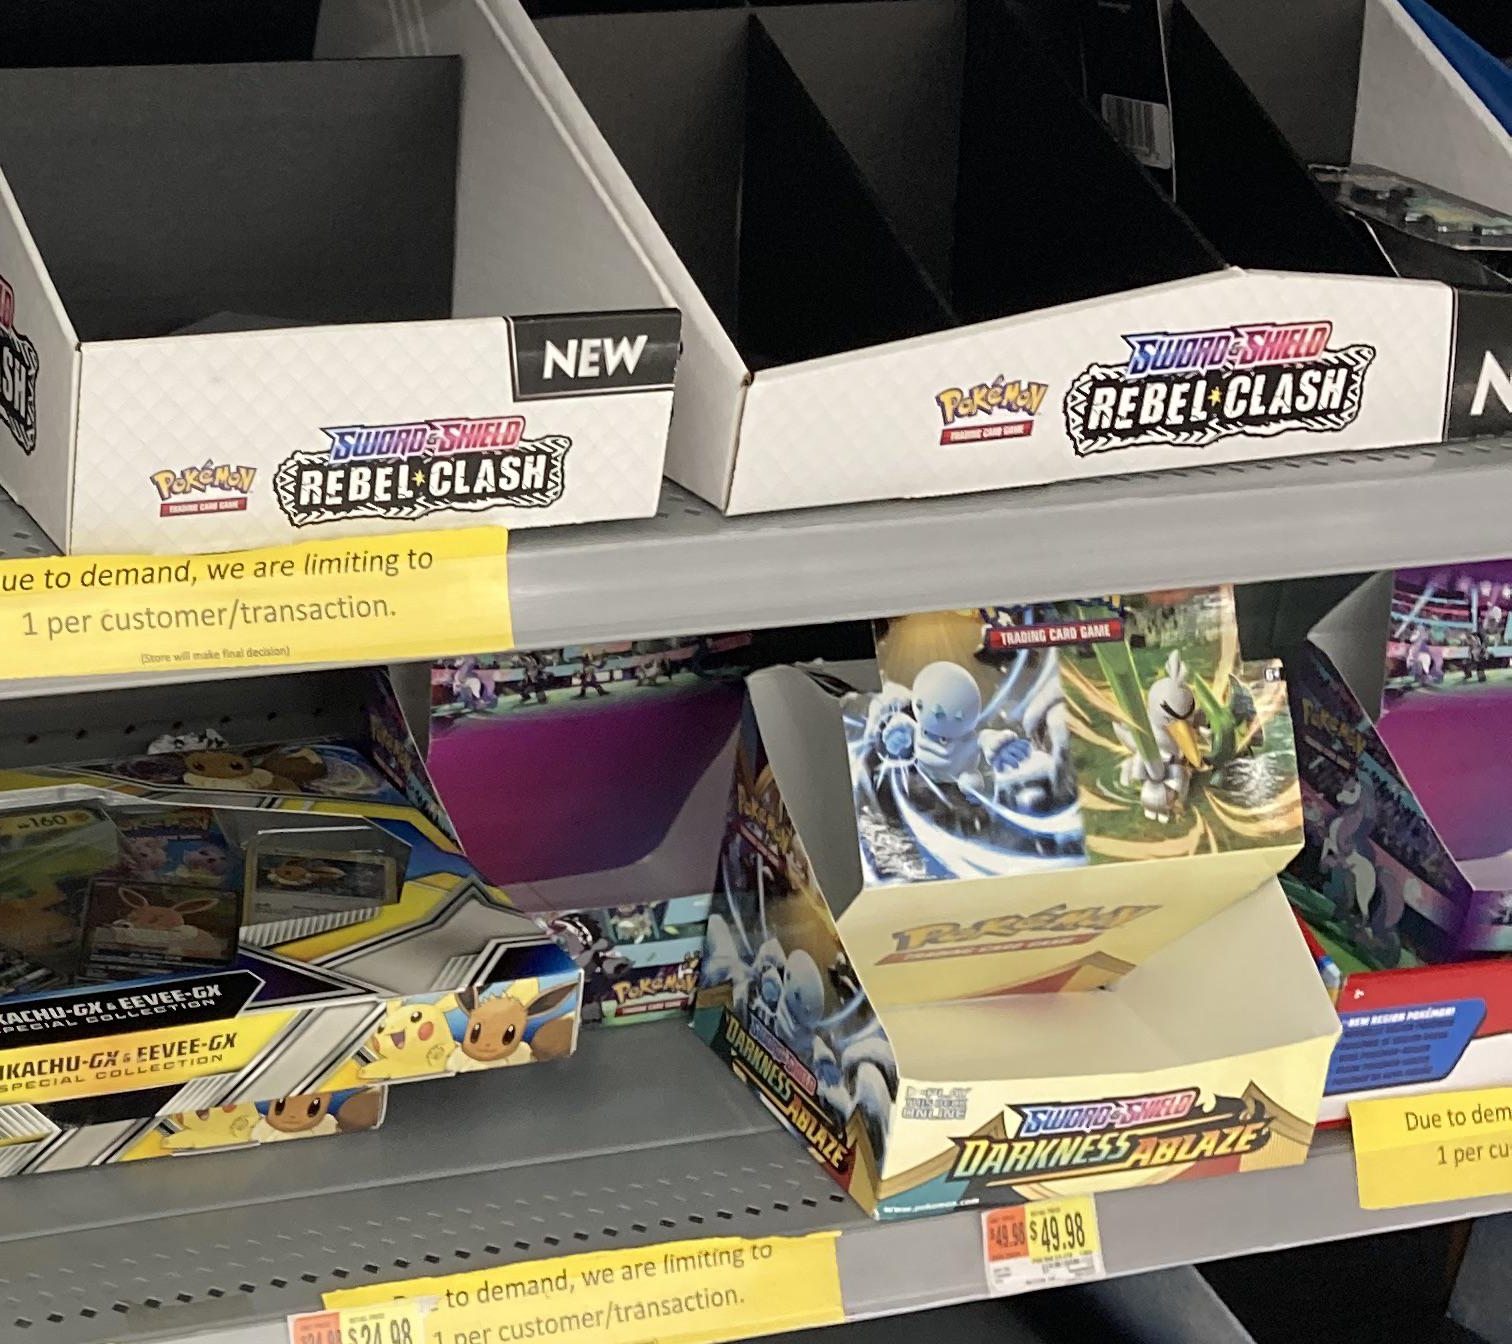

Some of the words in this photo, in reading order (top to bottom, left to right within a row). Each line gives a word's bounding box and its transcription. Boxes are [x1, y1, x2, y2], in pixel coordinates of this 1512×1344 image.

[542, 335, 648, 380] NEW
[1129, 332, 1232, 376] SWORD
[1240, 322, 1333, 368] SHIELD
[1088, 375, 1208, 430] REBEL
[1224, 368, 1346, 418] CLASH
[331, 424, 427, 462] SWORD
[431, 418, 524, 453] SHIELD
[299, 463, 414, 508] REBEL
[433, 454, 547, 498] CLASH
[38, 567, 70, 591] to
[80, 560, 198, 590] demand,
[207, 561, 246, 581] we
[253, 557, 296, 578] are
[303, 550, 401, 582] limiting
[405, 547, 433, 570] to
[22, 611, 37, 636] 1
[47, 610, 92, 642] per
[100, 596, 397, 633] customer/transaction.
[1000, 629, 1047, 646] TRADING
[1049, 626, 1077, 641] CARD
[1080, 624, 1111, 639] GAME
[86, 998, 216, 1025] COLLECTION
[121, 984, 223, 1011] EEVEE-GX
[95, 1054, 224, 1081] COLLECTION
[137, 1032, 238, 1060] EEVEE-GX
[726, 1013, 793, 1102] DARKNESS
[786, 1094, 849, 1169] ABLAZE
[1405, 1111, 1442, 1132] Due
[1446, 1108, 1467, 1127] to
[955, 1130, 1131, 1178] DARKNESS
[1127, 1123, 1258, 1168] ABLAZE
[1437, 1145, 1447, 1165] 1
[1454, 1144, 1482, 1168] per
[1030, 1213, 1086, 1252] $49.98
[446, 1287, 470, 1309] to
[476, 1269, 575, 1305] demand,
[581, 1268, 615, 1287] we
[621, 1260, 657, 1281] are
[664, 1246, 745, 1276] limiting
[752, 1243, 774, 1262] to
[498, 1290, 745, 1344] customer/transaction.
